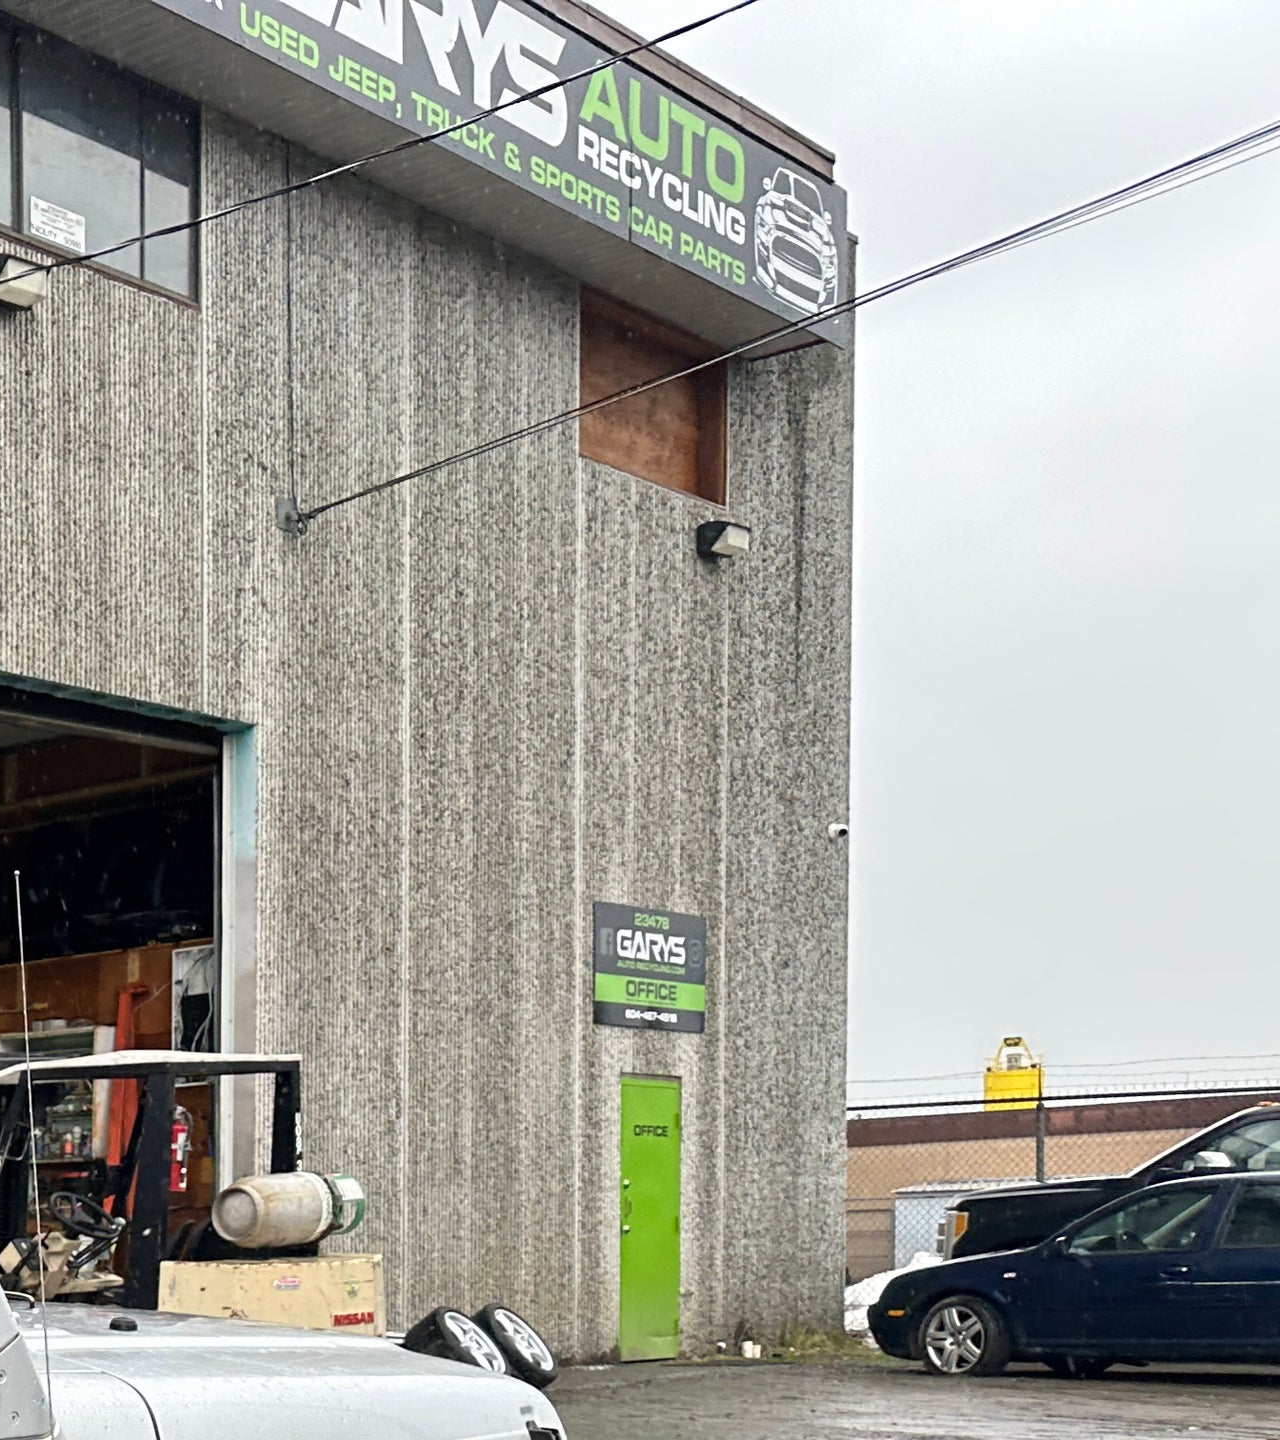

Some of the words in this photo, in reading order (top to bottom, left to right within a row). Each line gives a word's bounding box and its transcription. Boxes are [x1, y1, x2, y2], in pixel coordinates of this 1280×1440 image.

[240, 2, 320, 69] USED
[327, 54, 402, 120] JEEP,
[410, 91, 496, 161] TRUCK
[503, 141, 522, 173] &
[530, 154, 621, 224] SPORTS
[628, 204, 673, 250] CAR
[679, 232, 746, 285] PARTS
[579, 65, 745, 204] AUTO
[577, 124, 746, 245] RECYCLING
[634, 912, 670, 930] 23478
[617, 928, 686, 965] GARYS
[625, 980, 678, 1001] OFFICE
[633, 1124, 669, 1138] OFFICE
[333, 1311, 375, 1328] NISSAN
